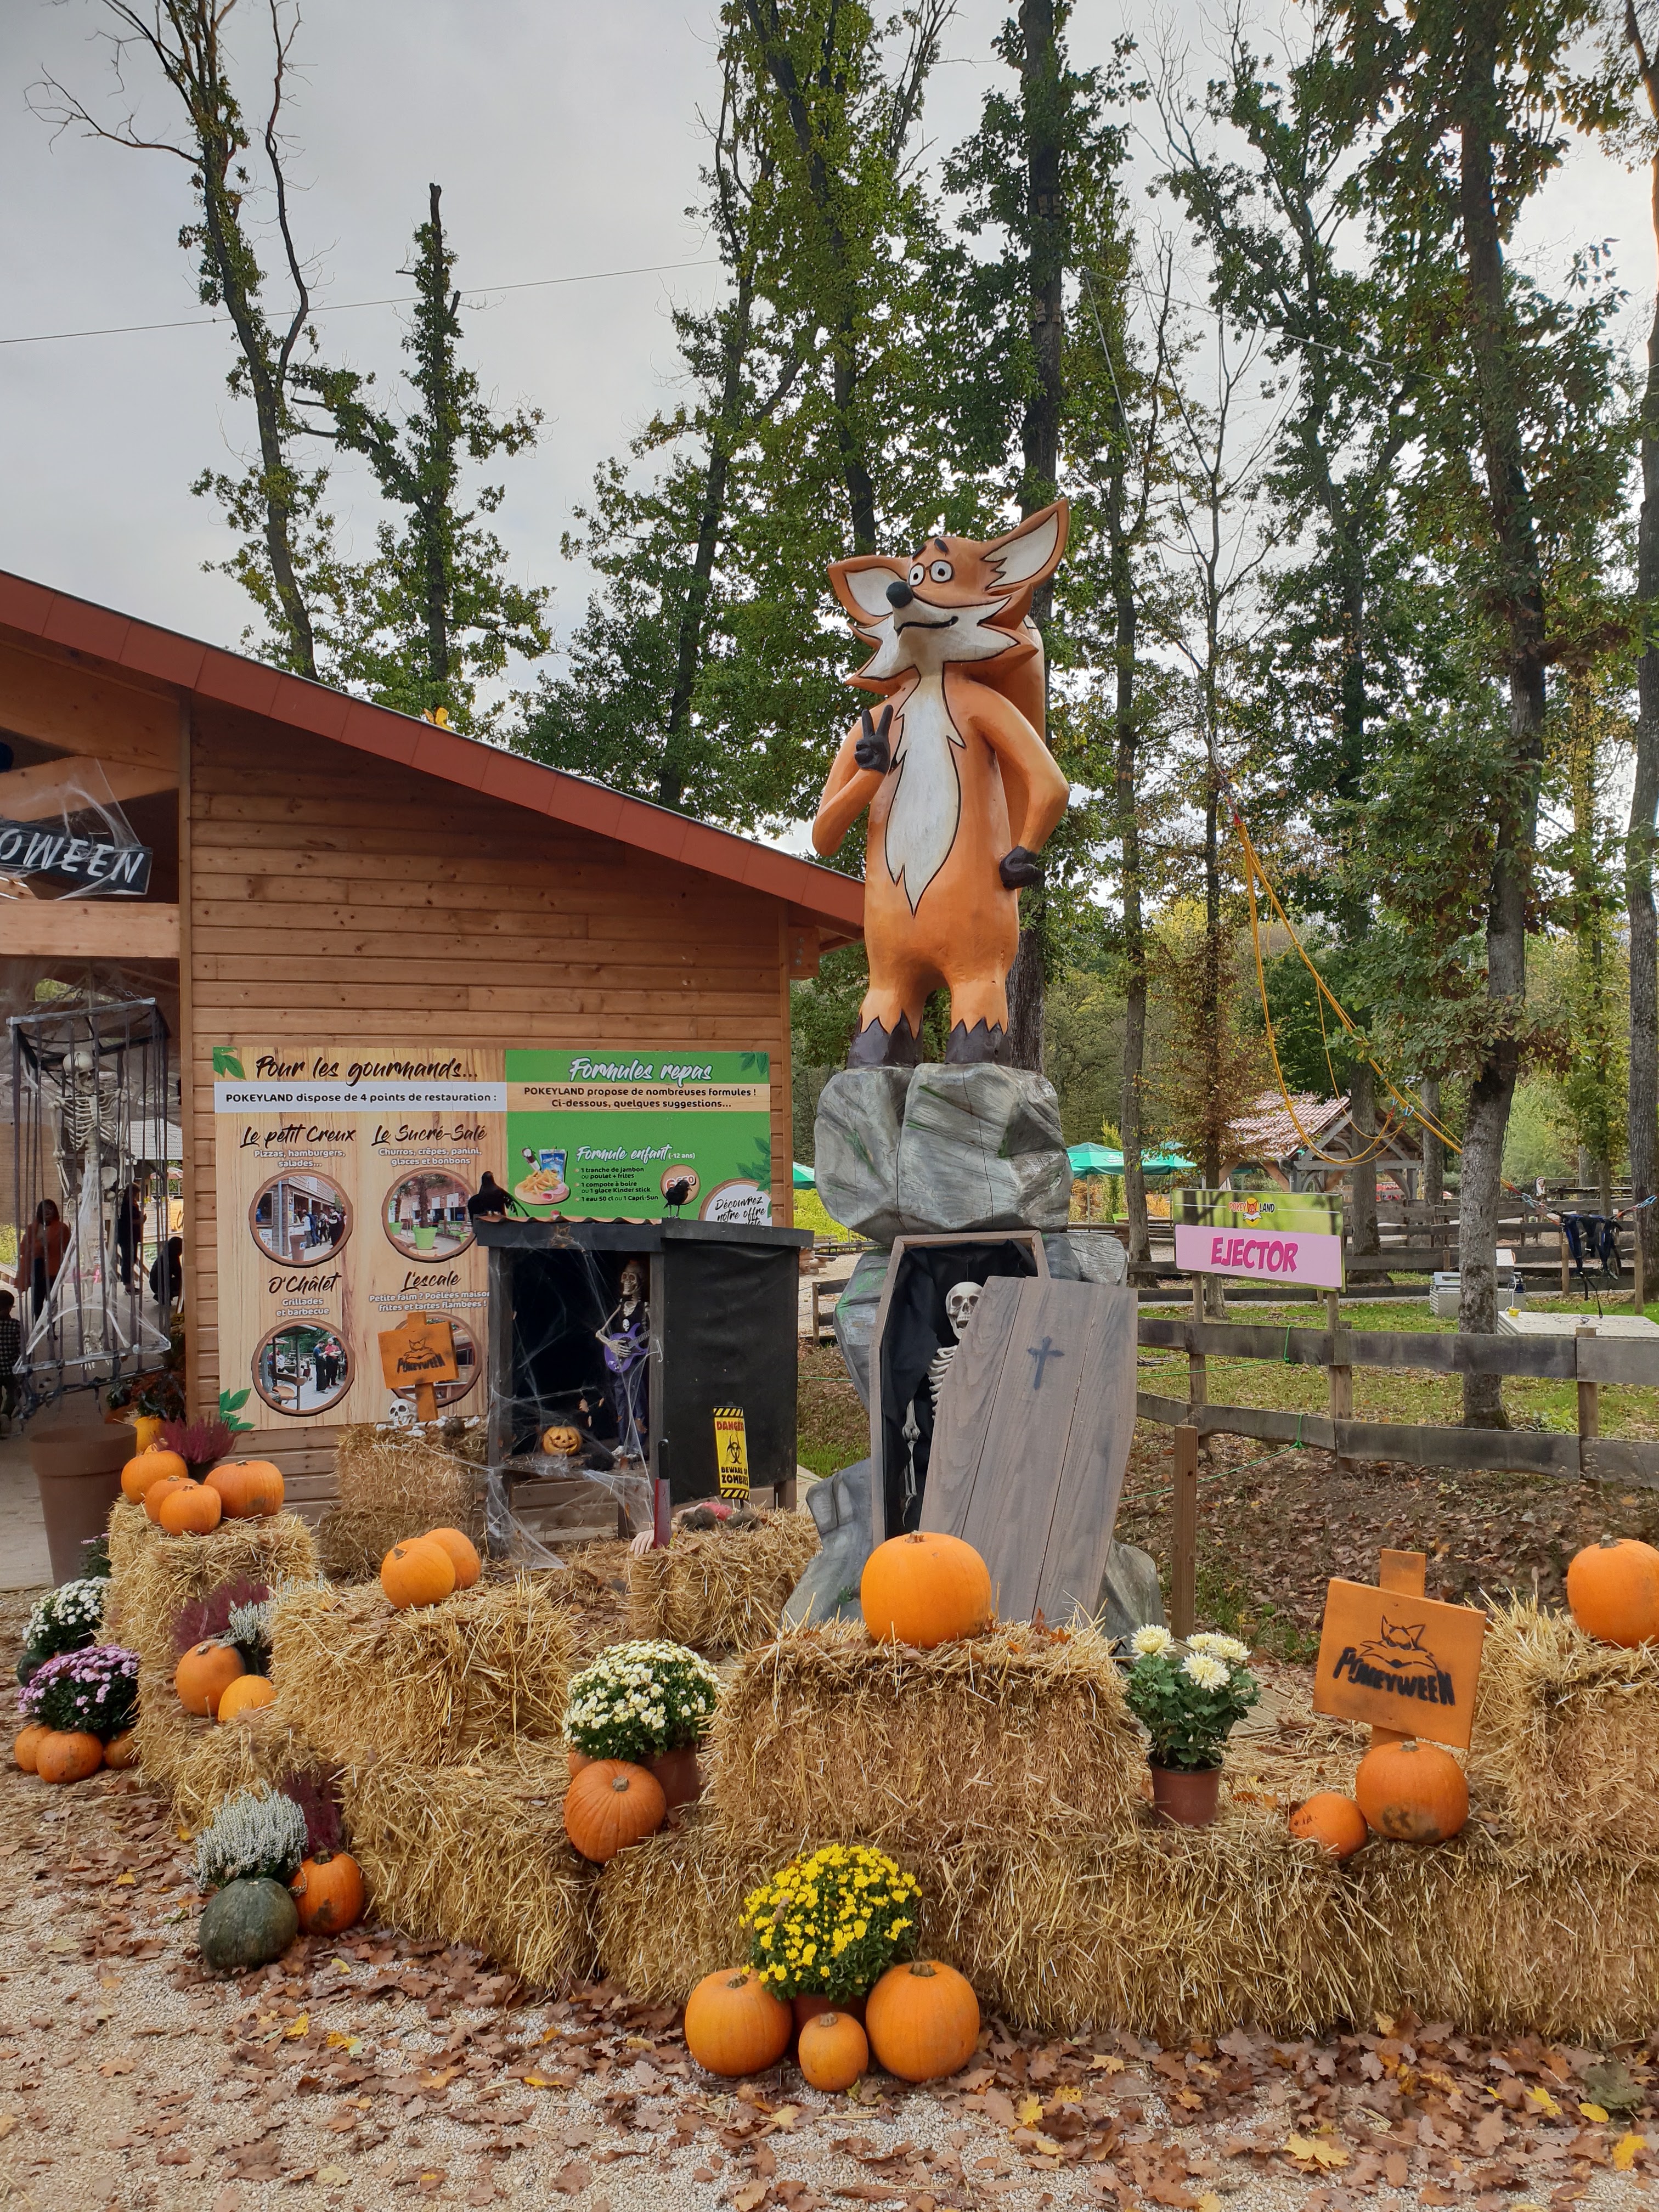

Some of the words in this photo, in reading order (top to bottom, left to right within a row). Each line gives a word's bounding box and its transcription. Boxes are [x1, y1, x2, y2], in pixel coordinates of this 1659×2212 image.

[0, 828, 145, 884] OWEEN
[256, 1056, 306, 1079] Pour
[313, 1057, 340, 1079] les
[346, 1058, 477, 1087] gourmands...
[569, 1057, 654, 1082] Formules
[660, 1064, 713, 1087] repas
[524, 1087, 584, 1095] POKEYLAND
[587, 1087, 629, 1096] propose
[709, 1088, 751, 1096] formules
[296, 1093, 341, 1103] dispose
[344, 1093, 357, 1102] de
[370, 1093, 405, 1103] points
[408, 1093, 421, 1101] de
[425, 1093, 491, 1101] restauration
[552, 1099, 611, 1108] Ci-dessous,
[614, 1099, 660, 1109] quelques
[662, 1099, 731, 1109] suggestions...
[240, 1126, 261, 1148] Le
[264, 1124, 306, 1148] petit
[307, 1126, 356, 1142] Creux
[371, 1125, 391, 1146] Le
[395, 1124, 487, 1142] Sucré-Salé
[255, 1150, 286, 1158] Pizzas,
[288, 1149, 346, 1158] hamburgers,
[379, 1148, 416, 1156] Churros,
[418, 1147, 449, 1156] crêpes,
[452, 1147, 482, 1156] panini,
[576, 1145, 628, 1163] Formule
[630, 1144, 673, 1164] enfant
[391, 1158, 420, 1166] glaces
[715, 1197, 763, 1210] Découvrez
[1228, 1201, 1248, 1212] POKEY
[1259, 1203, 1275, 1213] LAND
[717, 1209, 741, 1223] notre
[743, 1206, 766, 1221] offre
[1211, 1237, 1299, 1272] EJECTOR
[268, 1272, 342, 1295] O'Châlet
[400, 1271, 461, 1293] L'escale
[425, 1291, 459, 1300] Poêlées
[282, 1298, 323, 1306] Grillades
[379, 1303, 403, 1312] frites
[442, 1300, 482, 1308] flambées
[716, 1421, 744, 1431] DANGER
[721, 1474, 748, 1486] ZOMBIES
